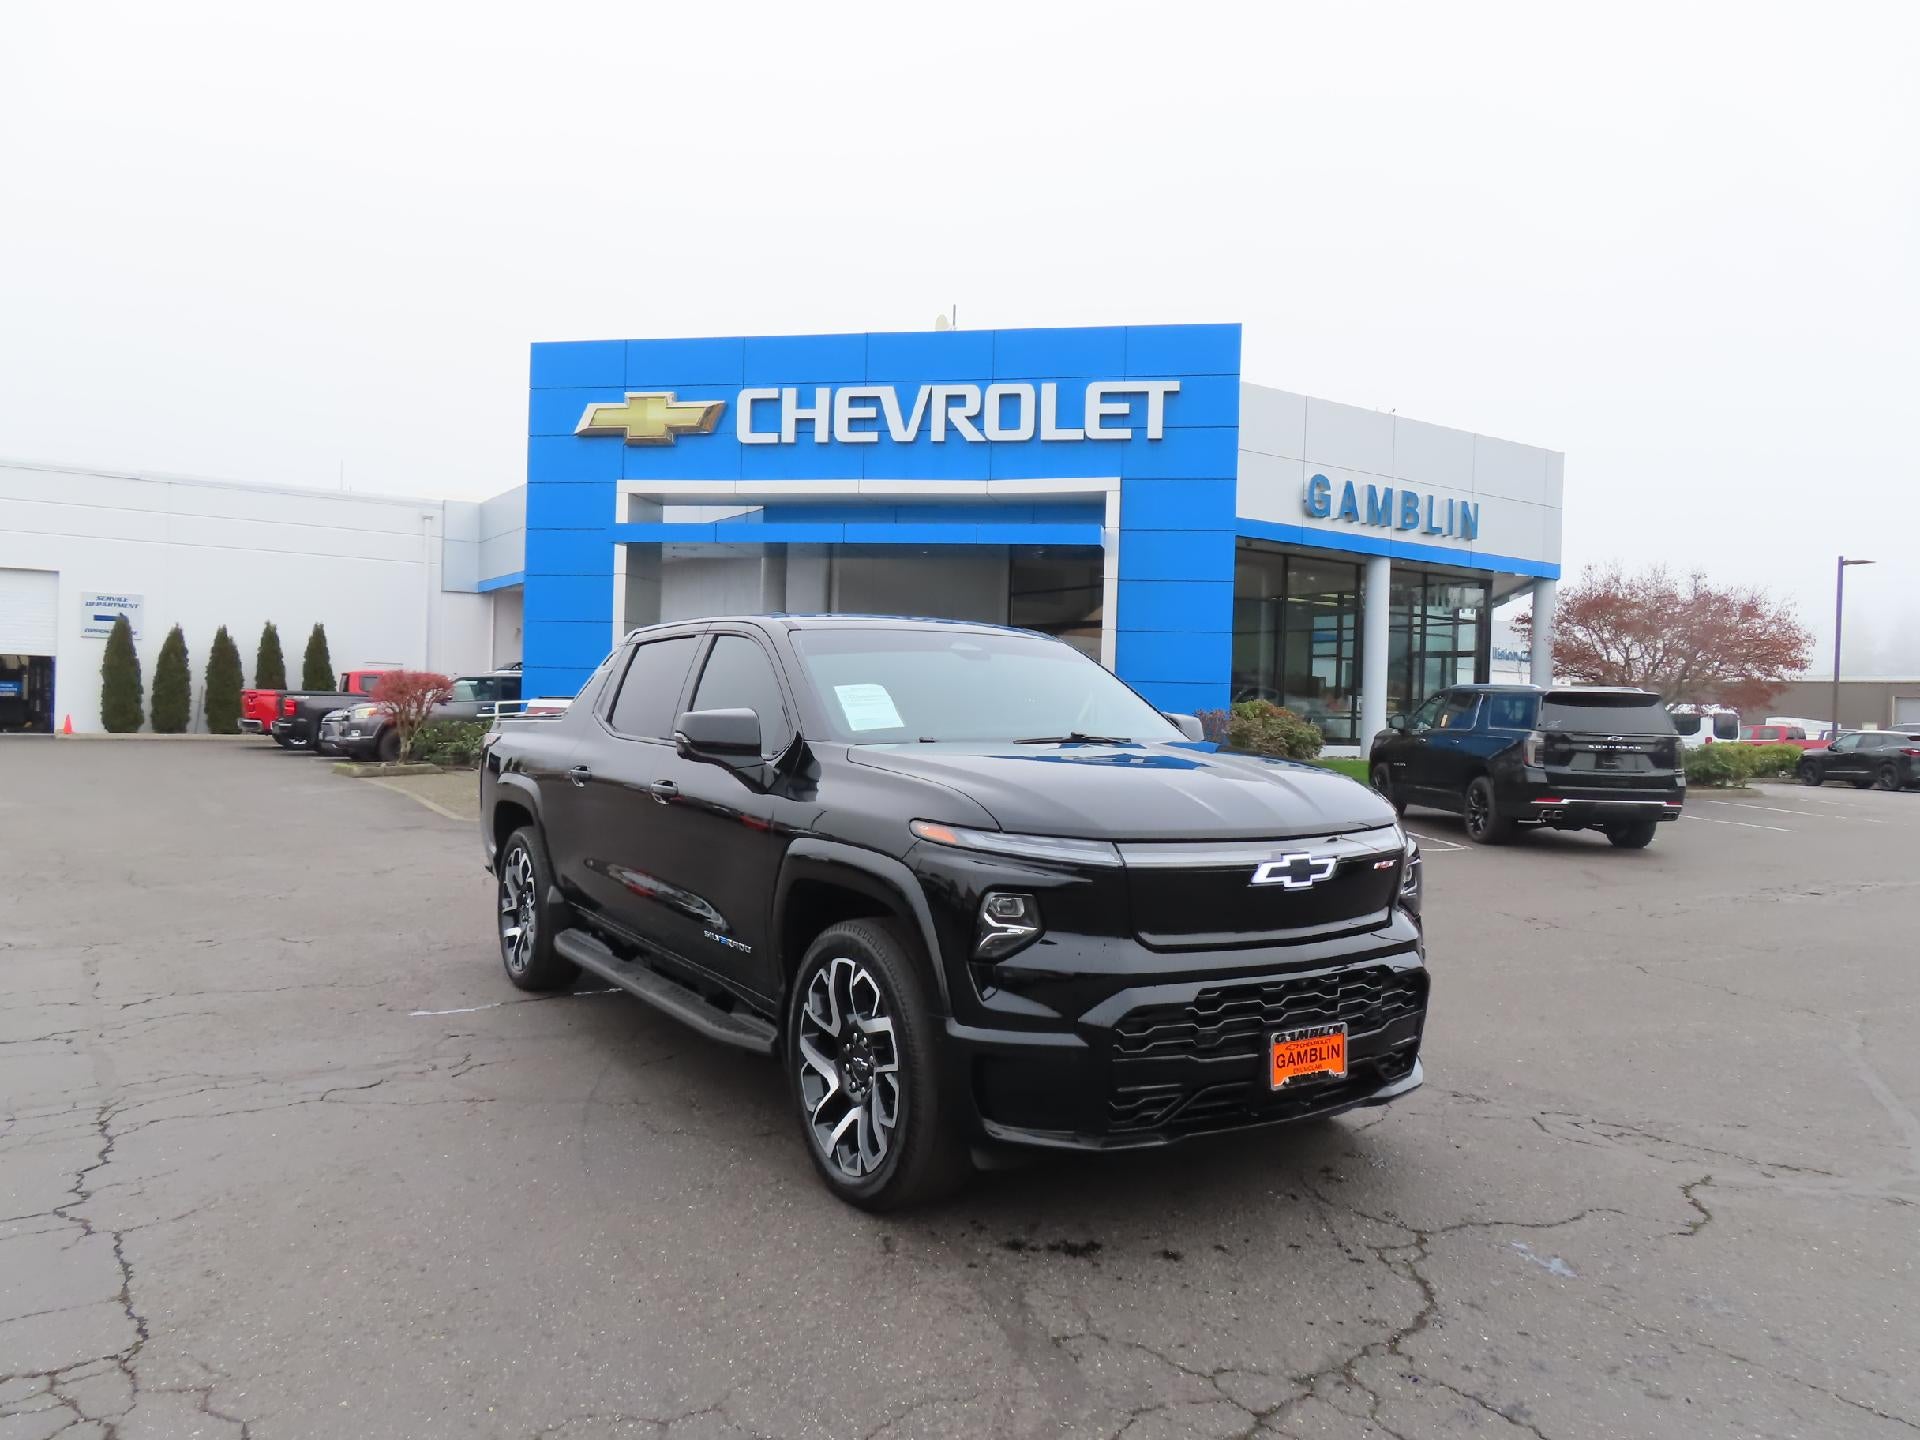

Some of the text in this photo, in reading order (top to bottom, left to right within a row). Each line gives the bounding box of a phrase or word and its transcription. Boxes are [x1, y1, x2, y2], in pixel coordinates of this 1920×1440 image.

[736, 381, 1181, 444] CHEVROLET
[1304, 473, 1479, 541] GAMBLIN
[85, 601, 139, 609] DEPARTMENT
[1276, 1043, 1341, 1069] GAMBLIN
